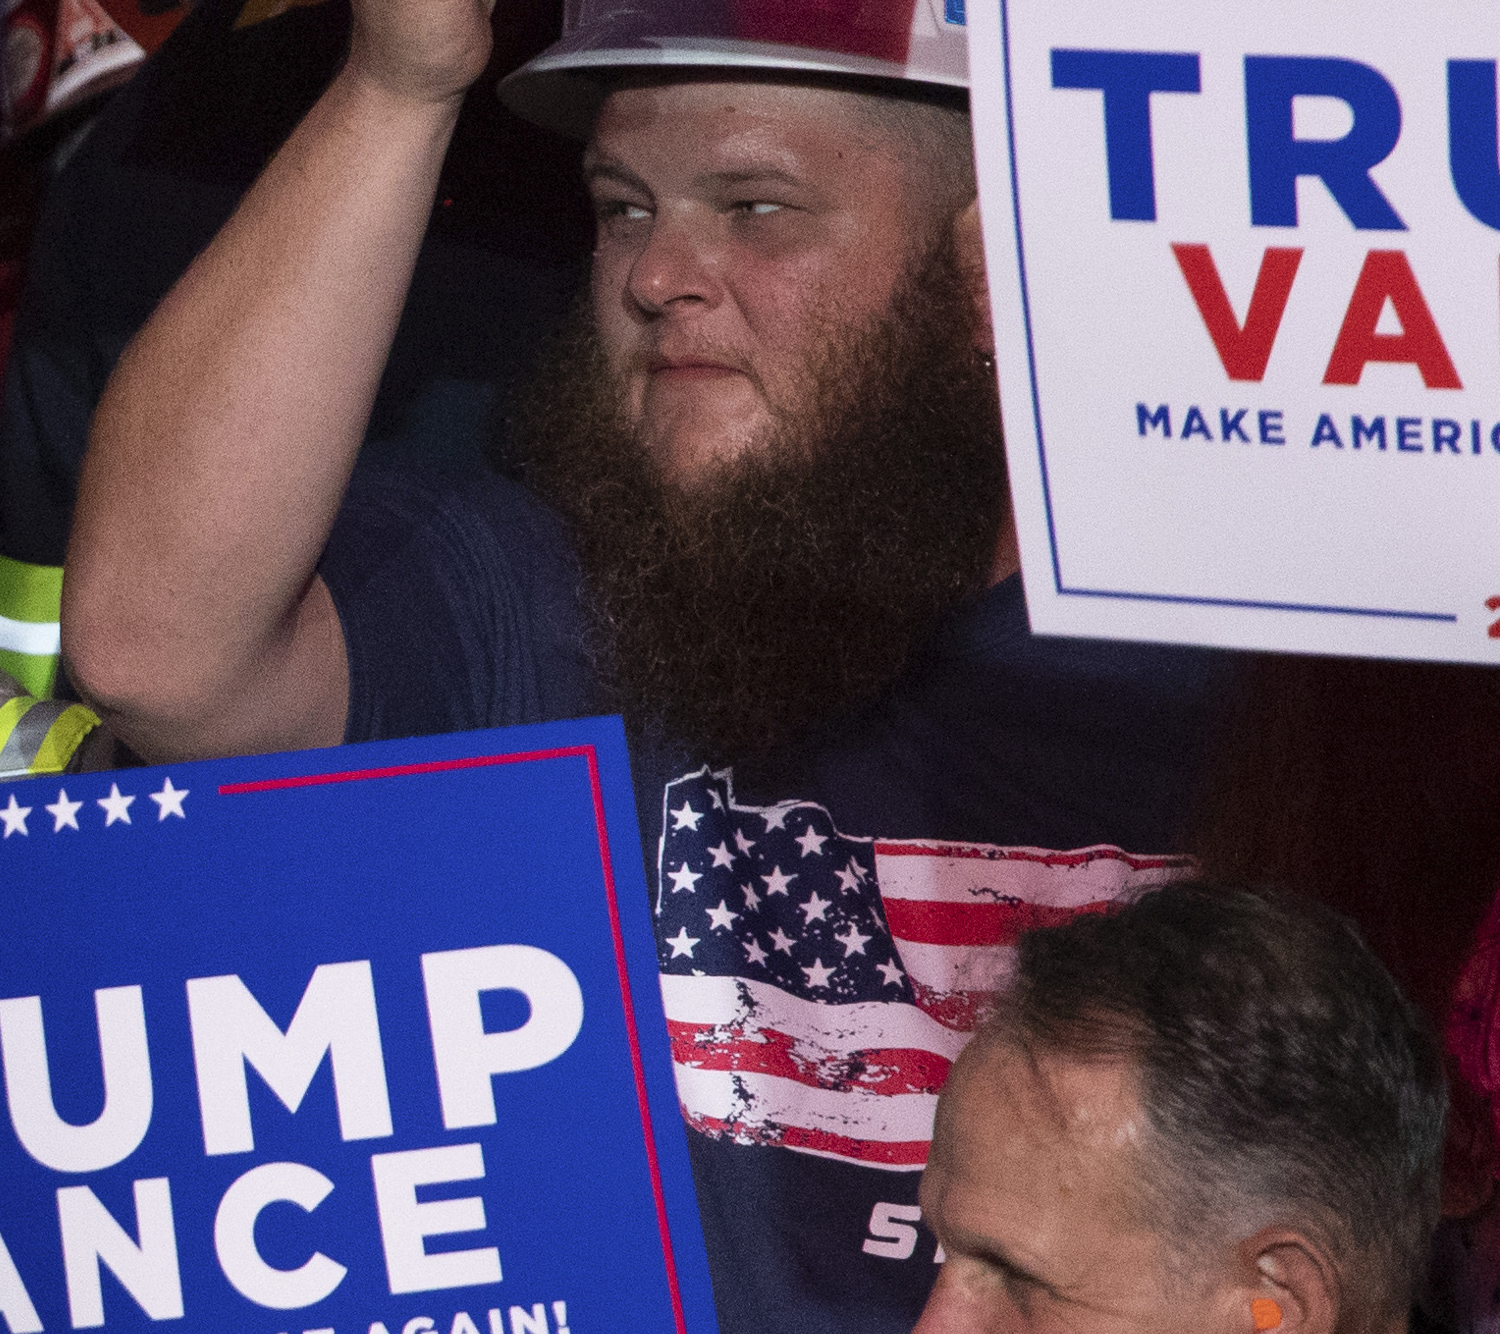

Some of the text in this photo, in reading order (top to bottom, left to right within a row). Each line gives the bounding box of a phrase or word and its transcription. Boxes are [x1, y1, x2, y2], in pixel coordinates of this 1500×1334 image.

[1169, 242, 1500, 391] VA
[1136, 402, 1500, 456] MAKE AMERI
